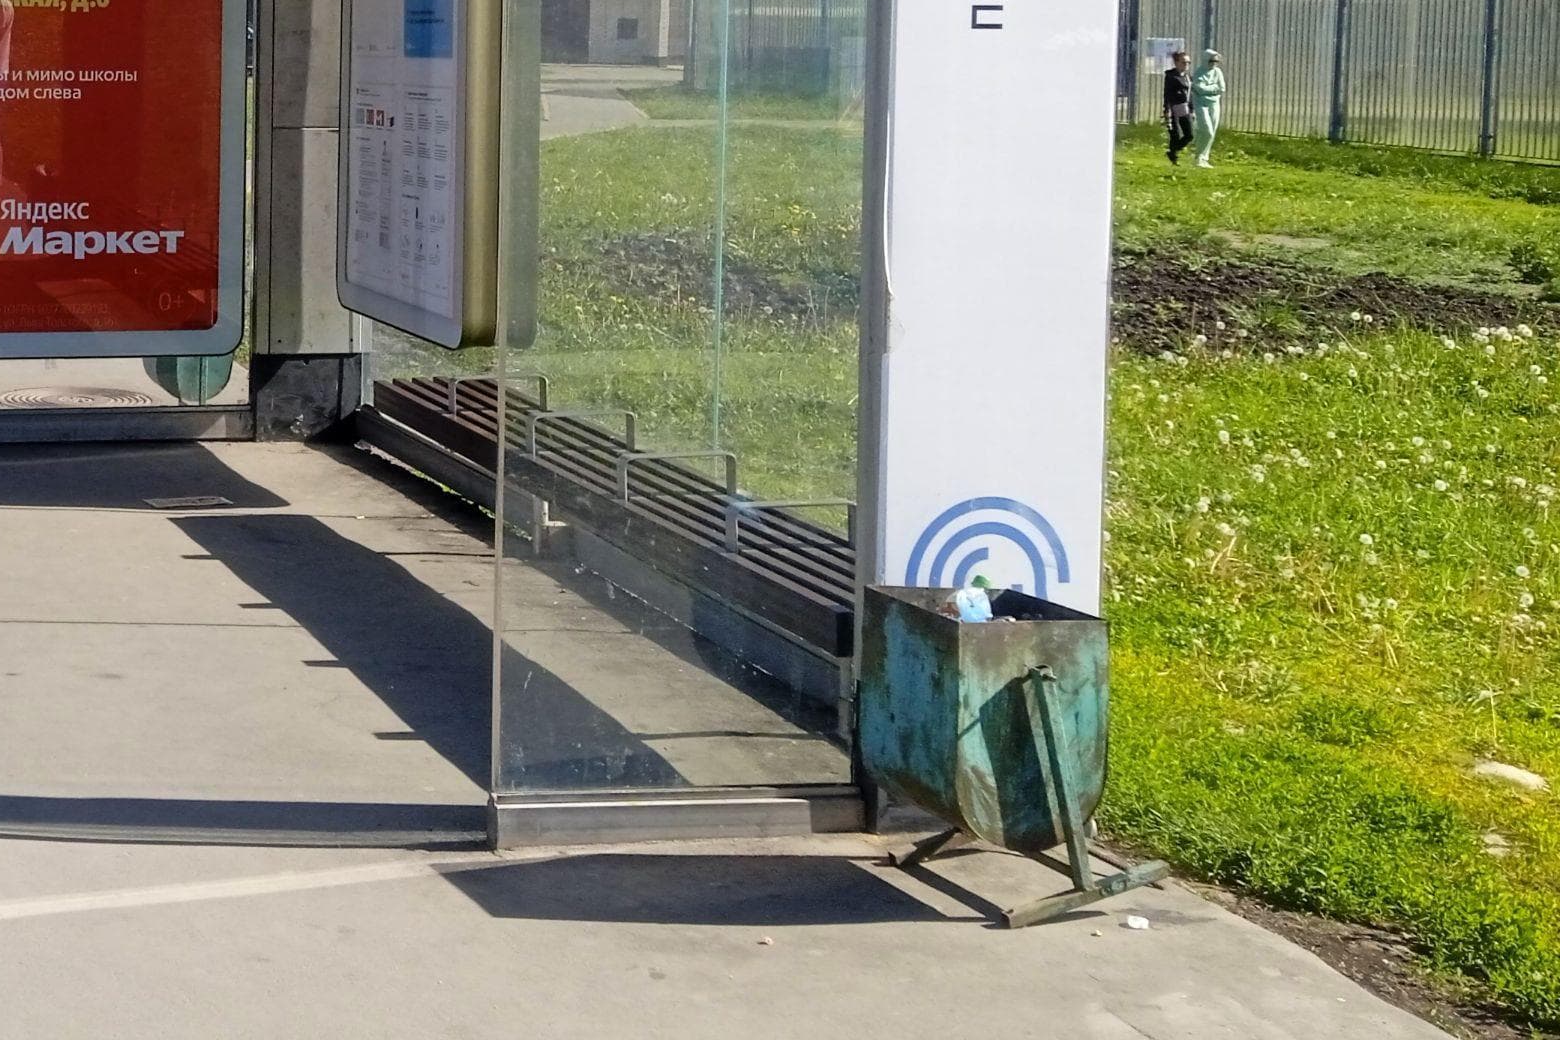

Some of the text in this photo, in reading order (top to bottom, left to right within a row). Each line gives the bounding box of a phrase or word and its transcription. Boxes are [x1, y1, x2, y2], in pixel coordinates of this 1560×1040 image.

[12, 70, 23, 81] и
[26, 70, 75, 82] мимо
[79, 70, 138, 82] школы
[33, 87, 82, 99] слева
[0, 199, 90, 223] Яндекс
